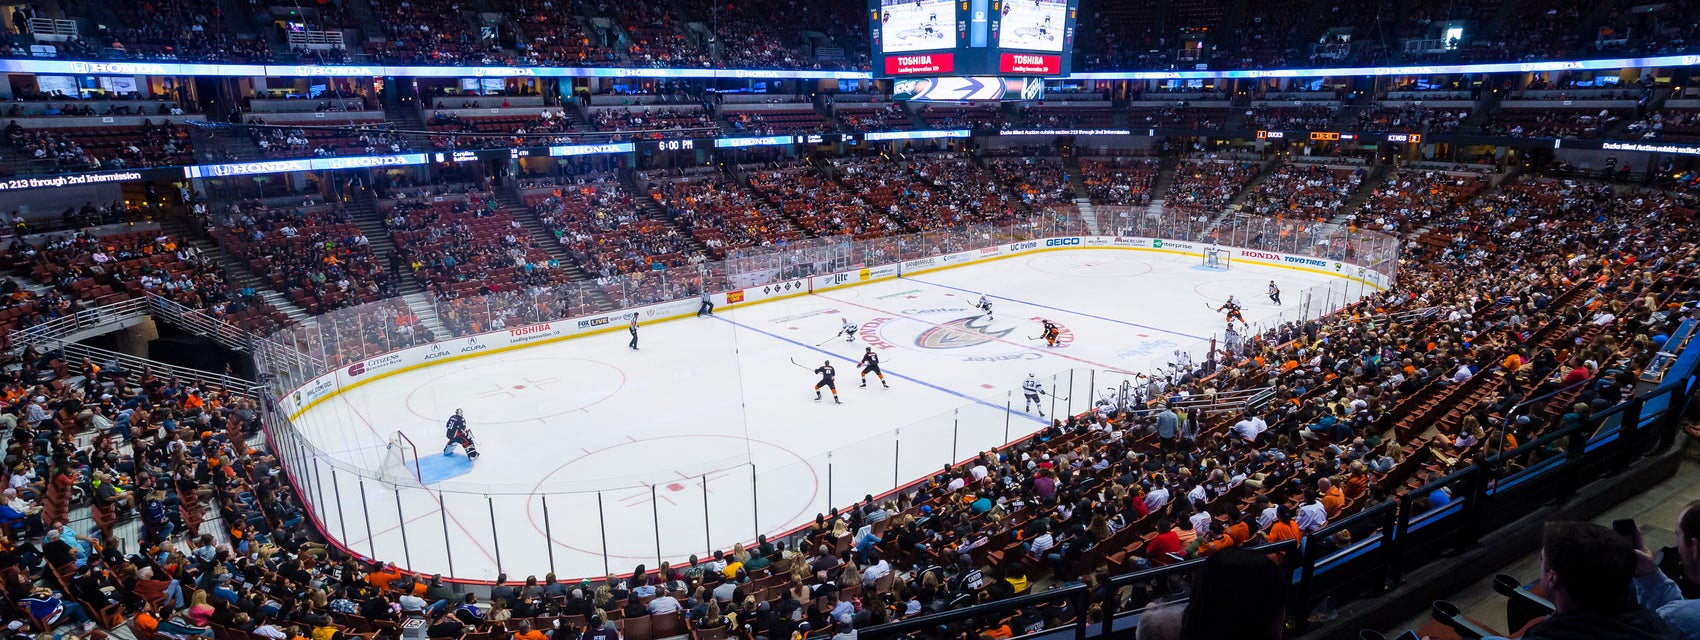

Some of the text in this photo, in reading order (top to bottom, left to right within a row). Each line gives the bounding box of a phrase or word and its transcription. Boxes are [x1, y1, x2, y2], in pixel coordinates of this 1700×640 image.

[898, 55, 932, 66] TOSHIBA
[1013, 55, 1043, 65] TOSHIBA
[90, 62, 167, 73] HONDA
[311, 66, 373, 76] HONDA
[485, 67, 535, 76] HONDA
[626, 67, 667, 77] HONDA
[1389, 66, 1432, 74] HONDA
[659, 140, 693, 150] 6:00 PM
[741, 137, 777, 146] HONDA
[576, 145, 620, 155] HONDA
[346, 155, 409, 166] HONDA
[233, 161, 299, 173] HONDA
[9, 179, 28, 189] 213
[30, 176, 67, 187] through
[68, 175, 85, 184] 2nd
[86, 172, 141, 183] Intermission
[1010, 240, 1037, 252] UC Irvine
[1046, 237, 1080, 247] GEICO
[1241, 250, 1281, 261] HONDA
[1284, 256, 1327, 267] TOYO TIRES
[835, 273, 848, 284] Lite
[902, 306, 968, 315] Center
[578, 319, 589, 327] FOX
[592, 317, 608, 326] LIVE
[510, 323, 551, 336] TOSHIBA
[859, 317, 897, 350] HONDA
[460, 344, 487, 352] ACURA
[424, 350, 451, 360] ACURA
[1026, 380, 1035, 388] 73
